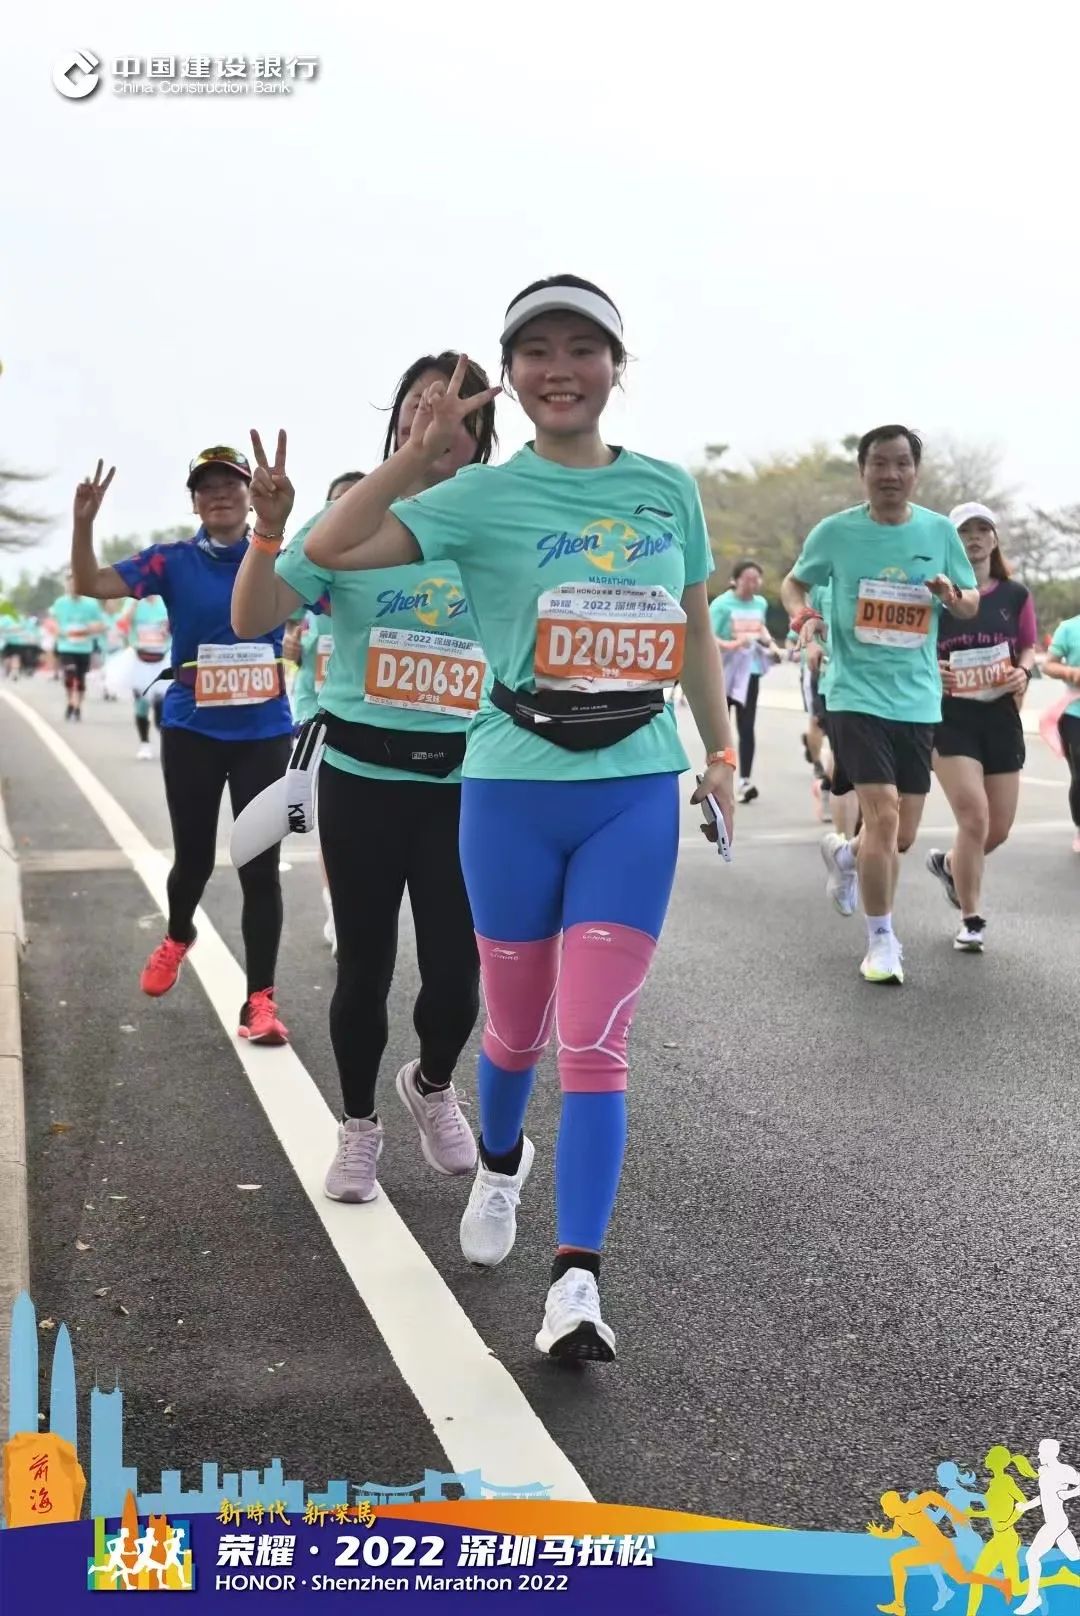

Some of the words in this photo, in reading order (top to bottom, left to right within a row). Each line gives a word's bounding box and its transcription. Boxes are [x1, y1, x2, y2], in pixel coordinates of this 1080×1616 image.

[537, 532, 600, 568] Shen
[588, 577, 636, 586] MARATHON
[376, 590, 429, 618] Shen
[583, 601, 611, 610] 2022
[864, 602, 926, 627] D10857
[407, 634, 431, 644] 2022
[549, 626, 675, 670] D20552
[201, 667, 273, 694] D20780
[377, 653, 479, 700] D20632
